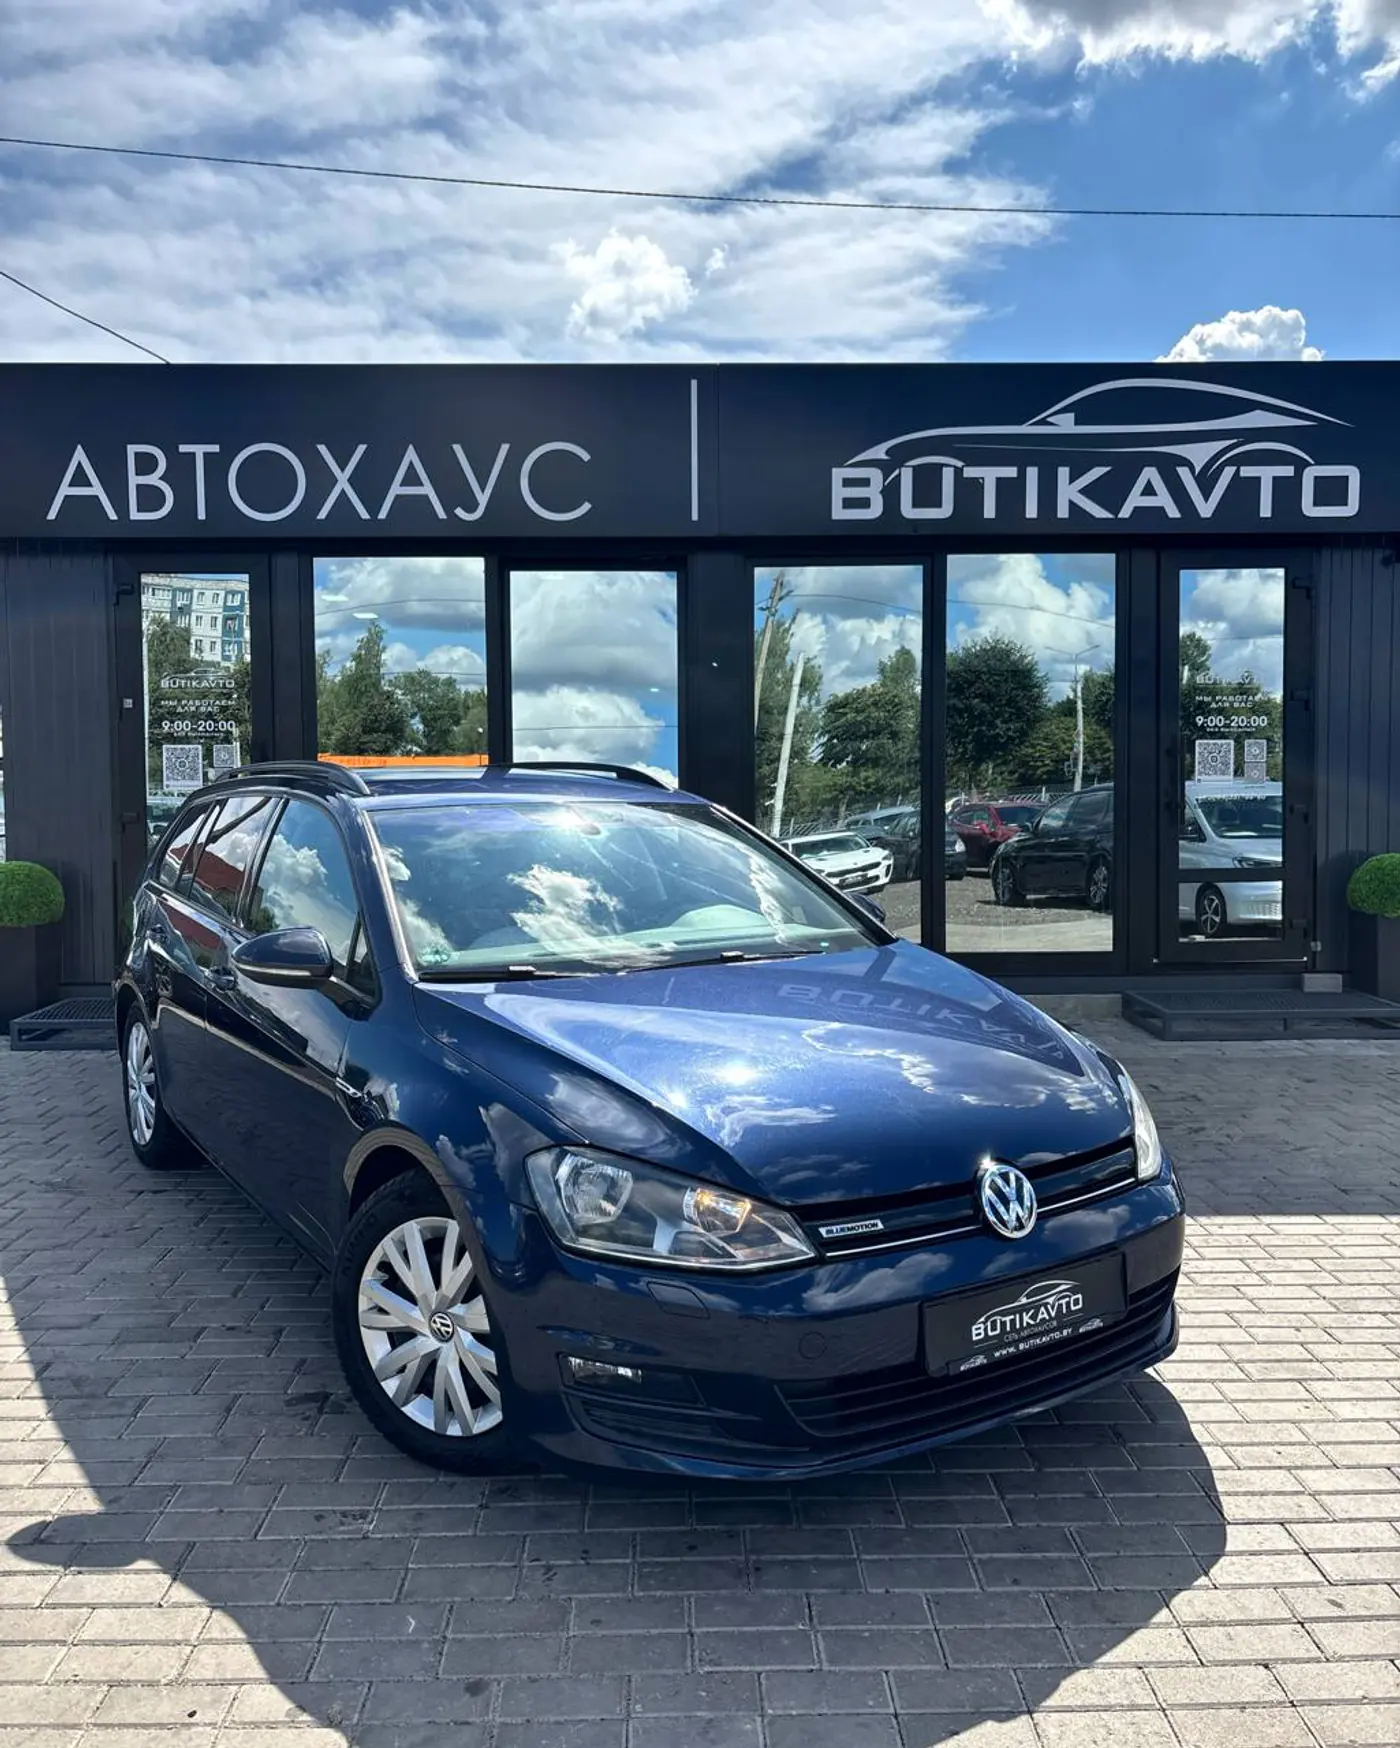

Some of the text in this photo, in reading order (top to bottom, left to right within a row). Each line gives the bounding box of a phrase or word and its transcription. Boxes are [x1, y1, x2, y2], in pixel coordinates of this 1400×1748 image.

[46, 441, 593, 521] АВТОХАУС
[831, 462, 1361, 519] BUTIKAVTO
[161, 679, 235, 688] BUTIKAVTO
[161, 720, 236, 731] 9:00-20:00
[1195, 715, 1268, 727] 9:00-20:00
[824, 1221, 880, 1236] BLUEMOTION
[971, 1293, 1083, 1341] BUTIKAVTO
